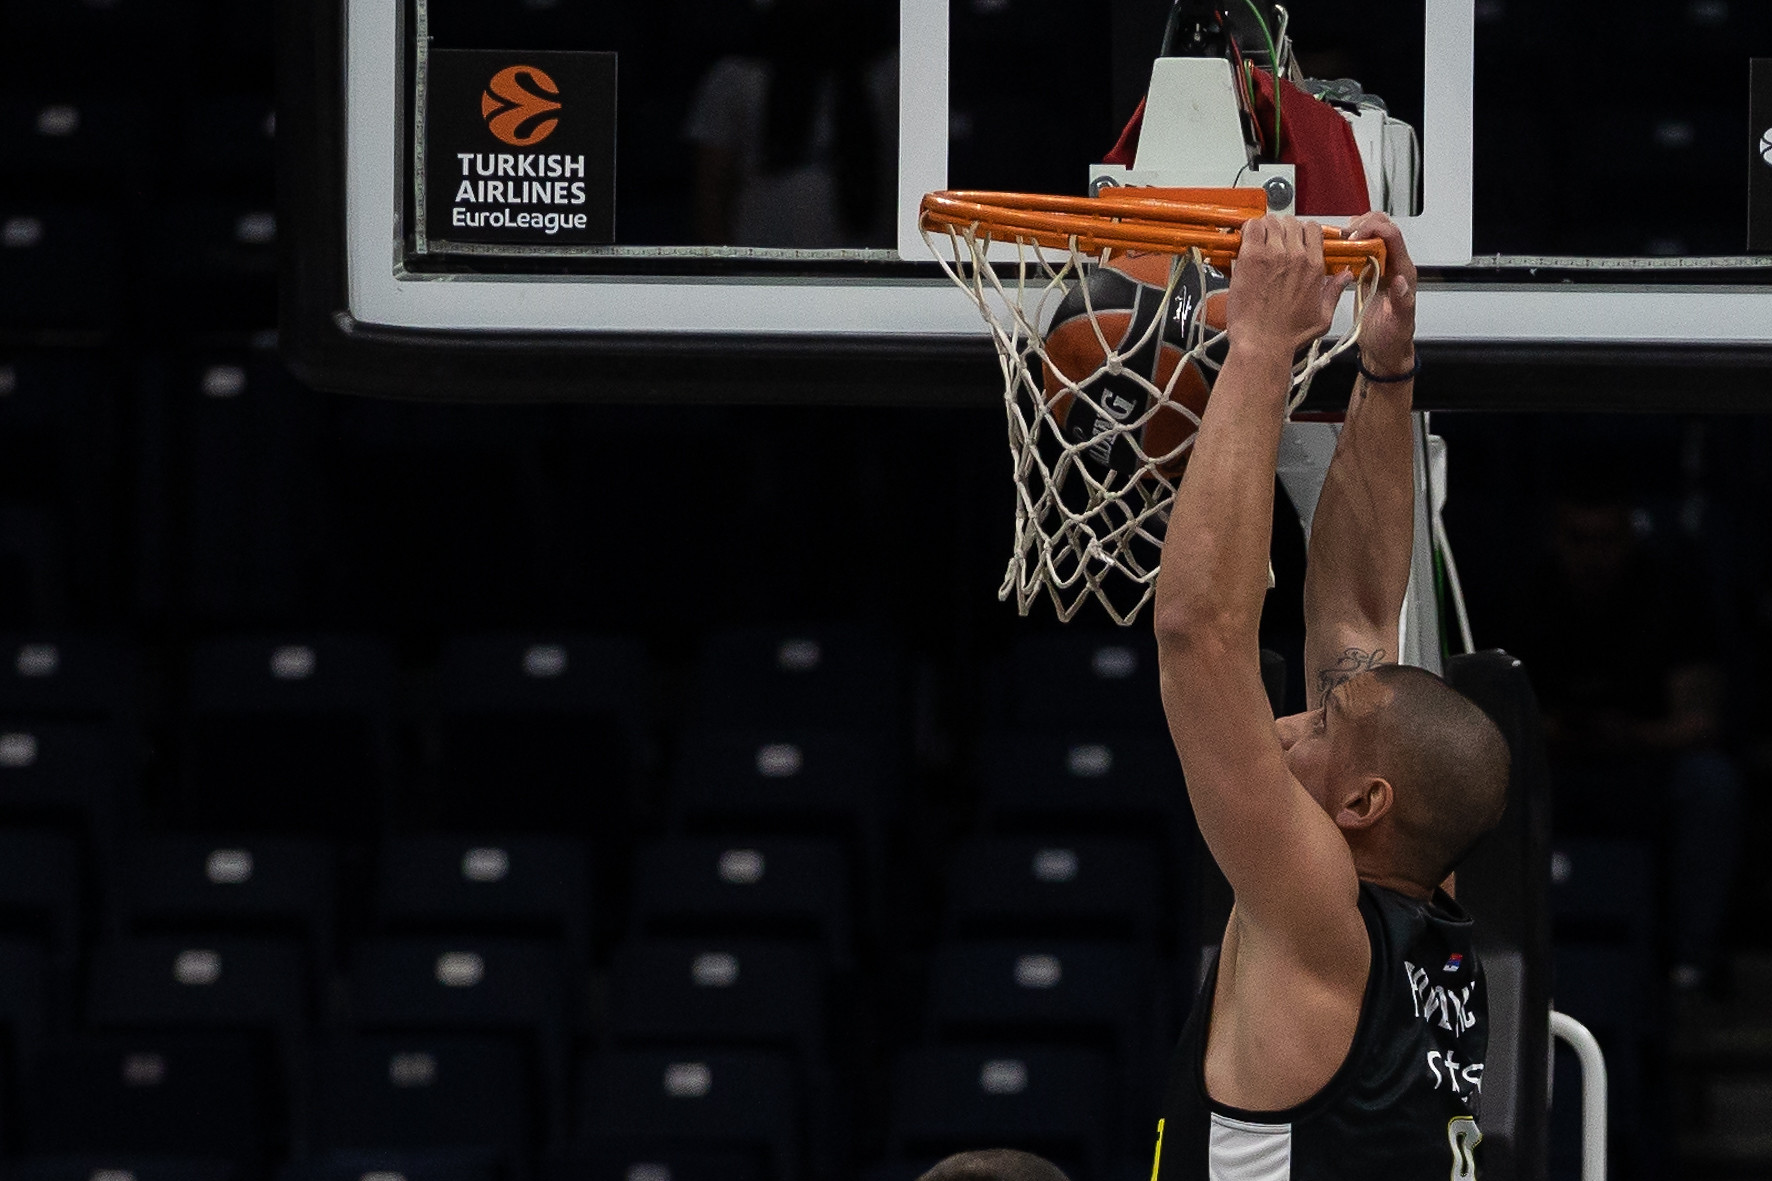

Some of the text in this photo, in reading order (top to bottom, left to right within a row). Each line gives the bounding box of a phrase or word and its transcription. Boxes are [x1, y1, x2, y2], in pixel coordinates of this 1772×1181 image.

[456, 152, 586, 178] TURKISH
[454, 179, 587, 204] AIRLINES
[452, 206, 588, 234] EuroLeague
